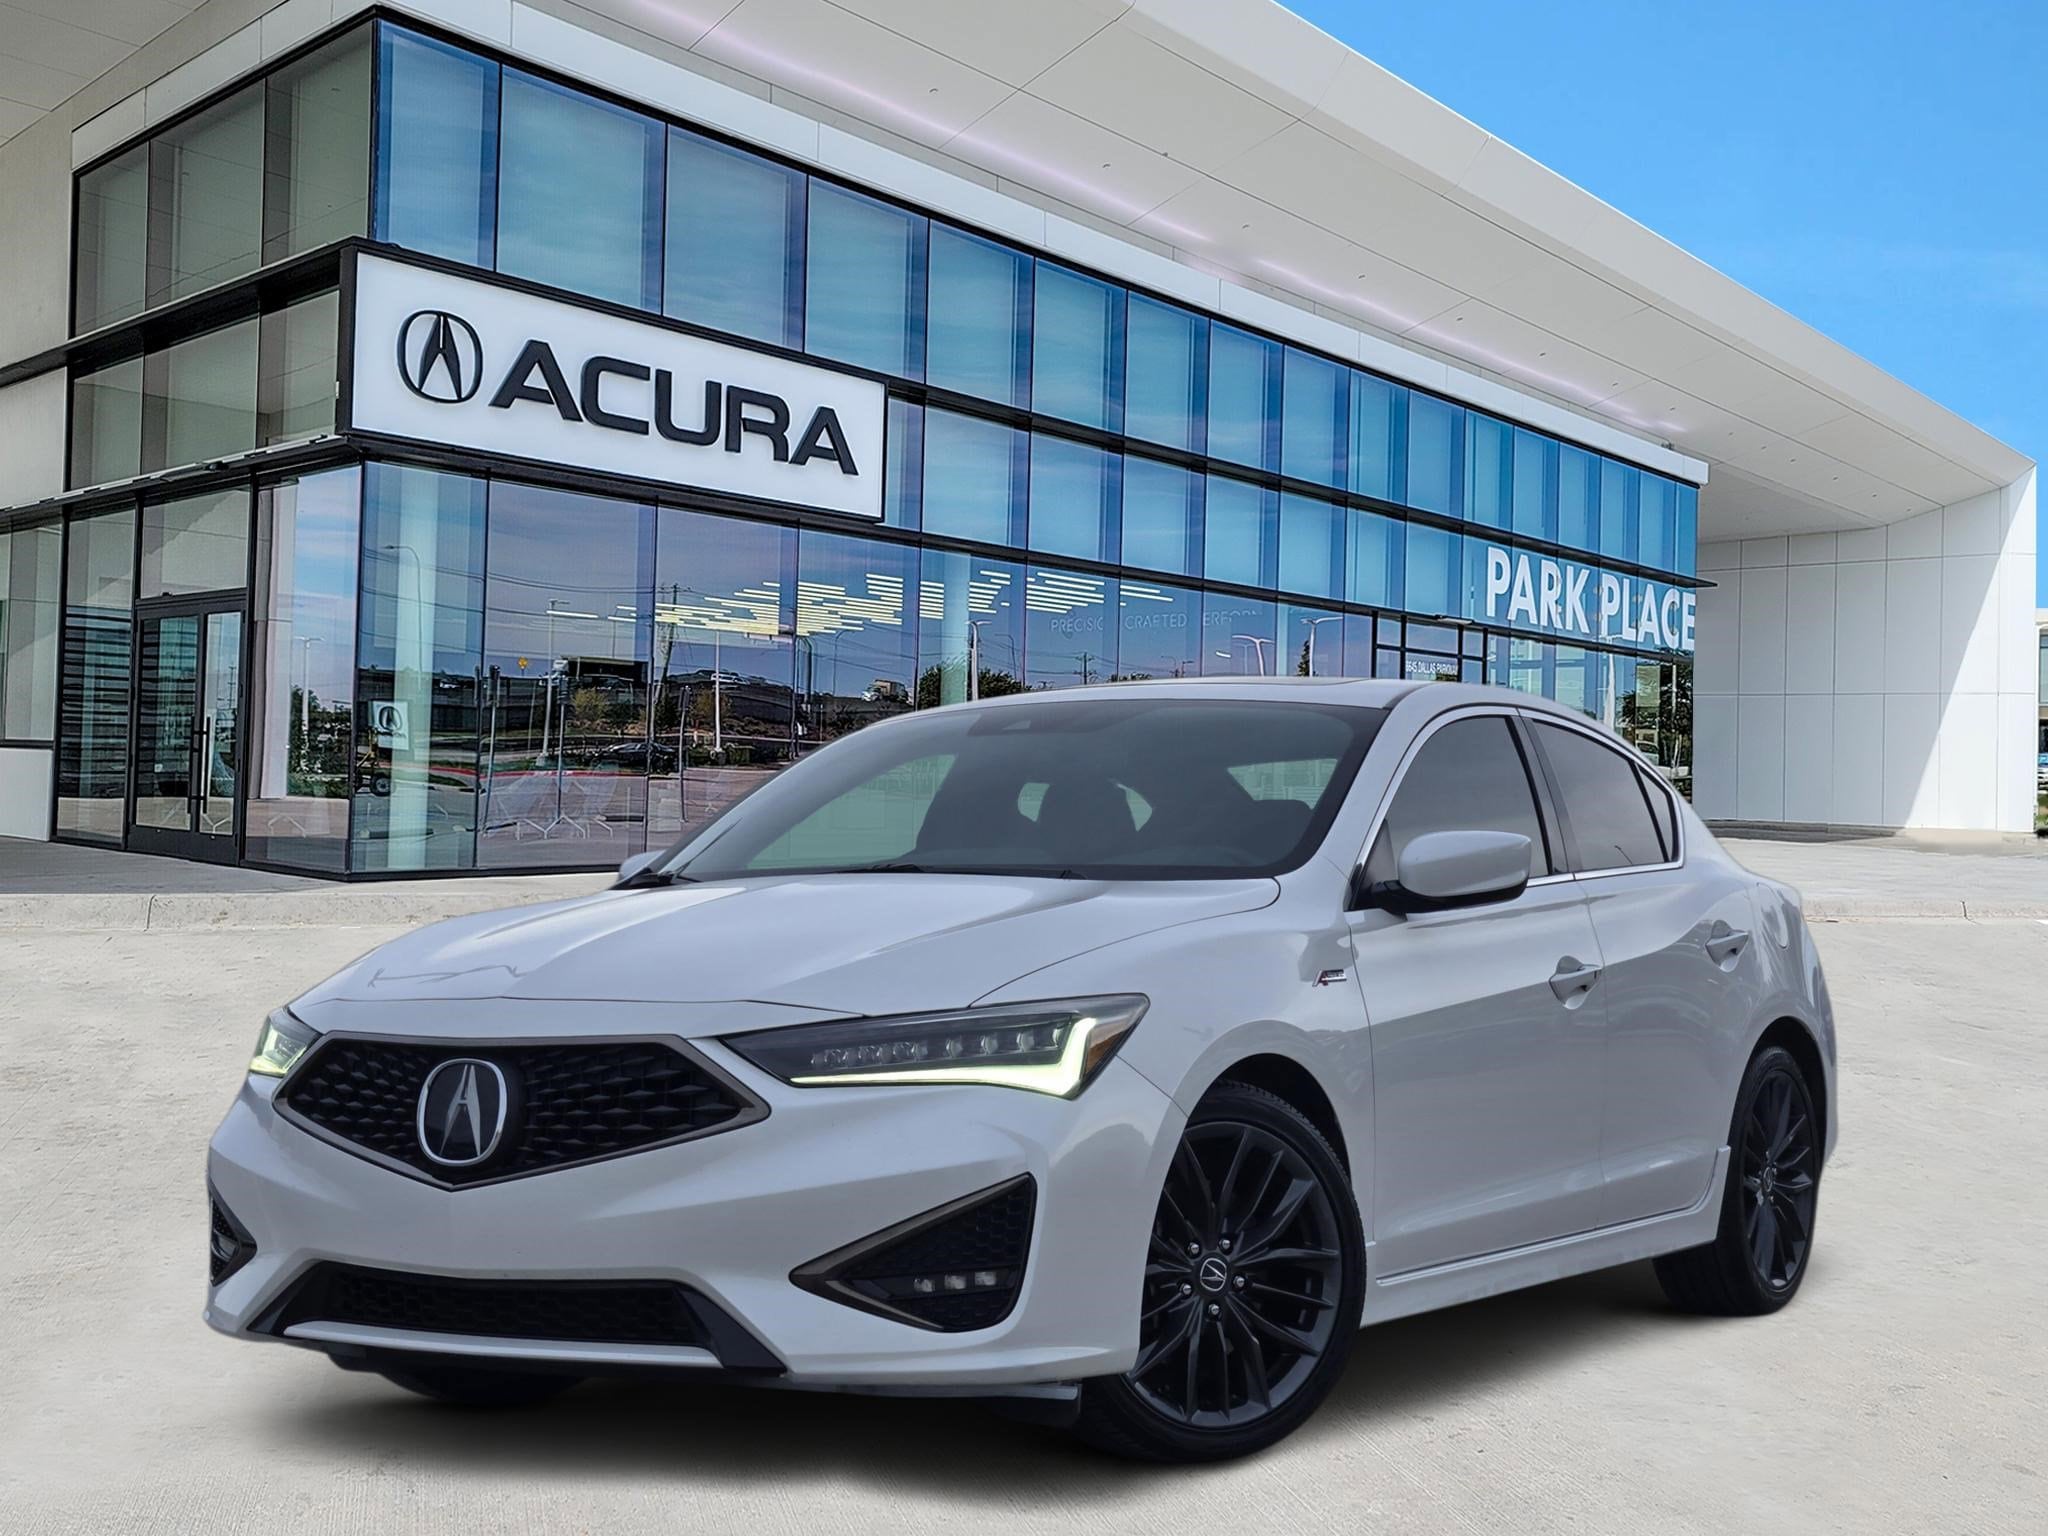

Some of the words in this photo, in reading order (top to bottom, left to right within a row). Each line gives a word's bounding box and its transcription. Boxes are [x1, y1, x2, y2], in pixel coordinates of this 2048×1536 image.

[488, 339, 859, 476] ACURA
[1051, 616, 1104, 632] PRECISIO
[1125, 612, 1187, 629] CRAFTED
[1486, 546, 1591, 634] PARK
[1600, 573, 1696, 650] PLACE
